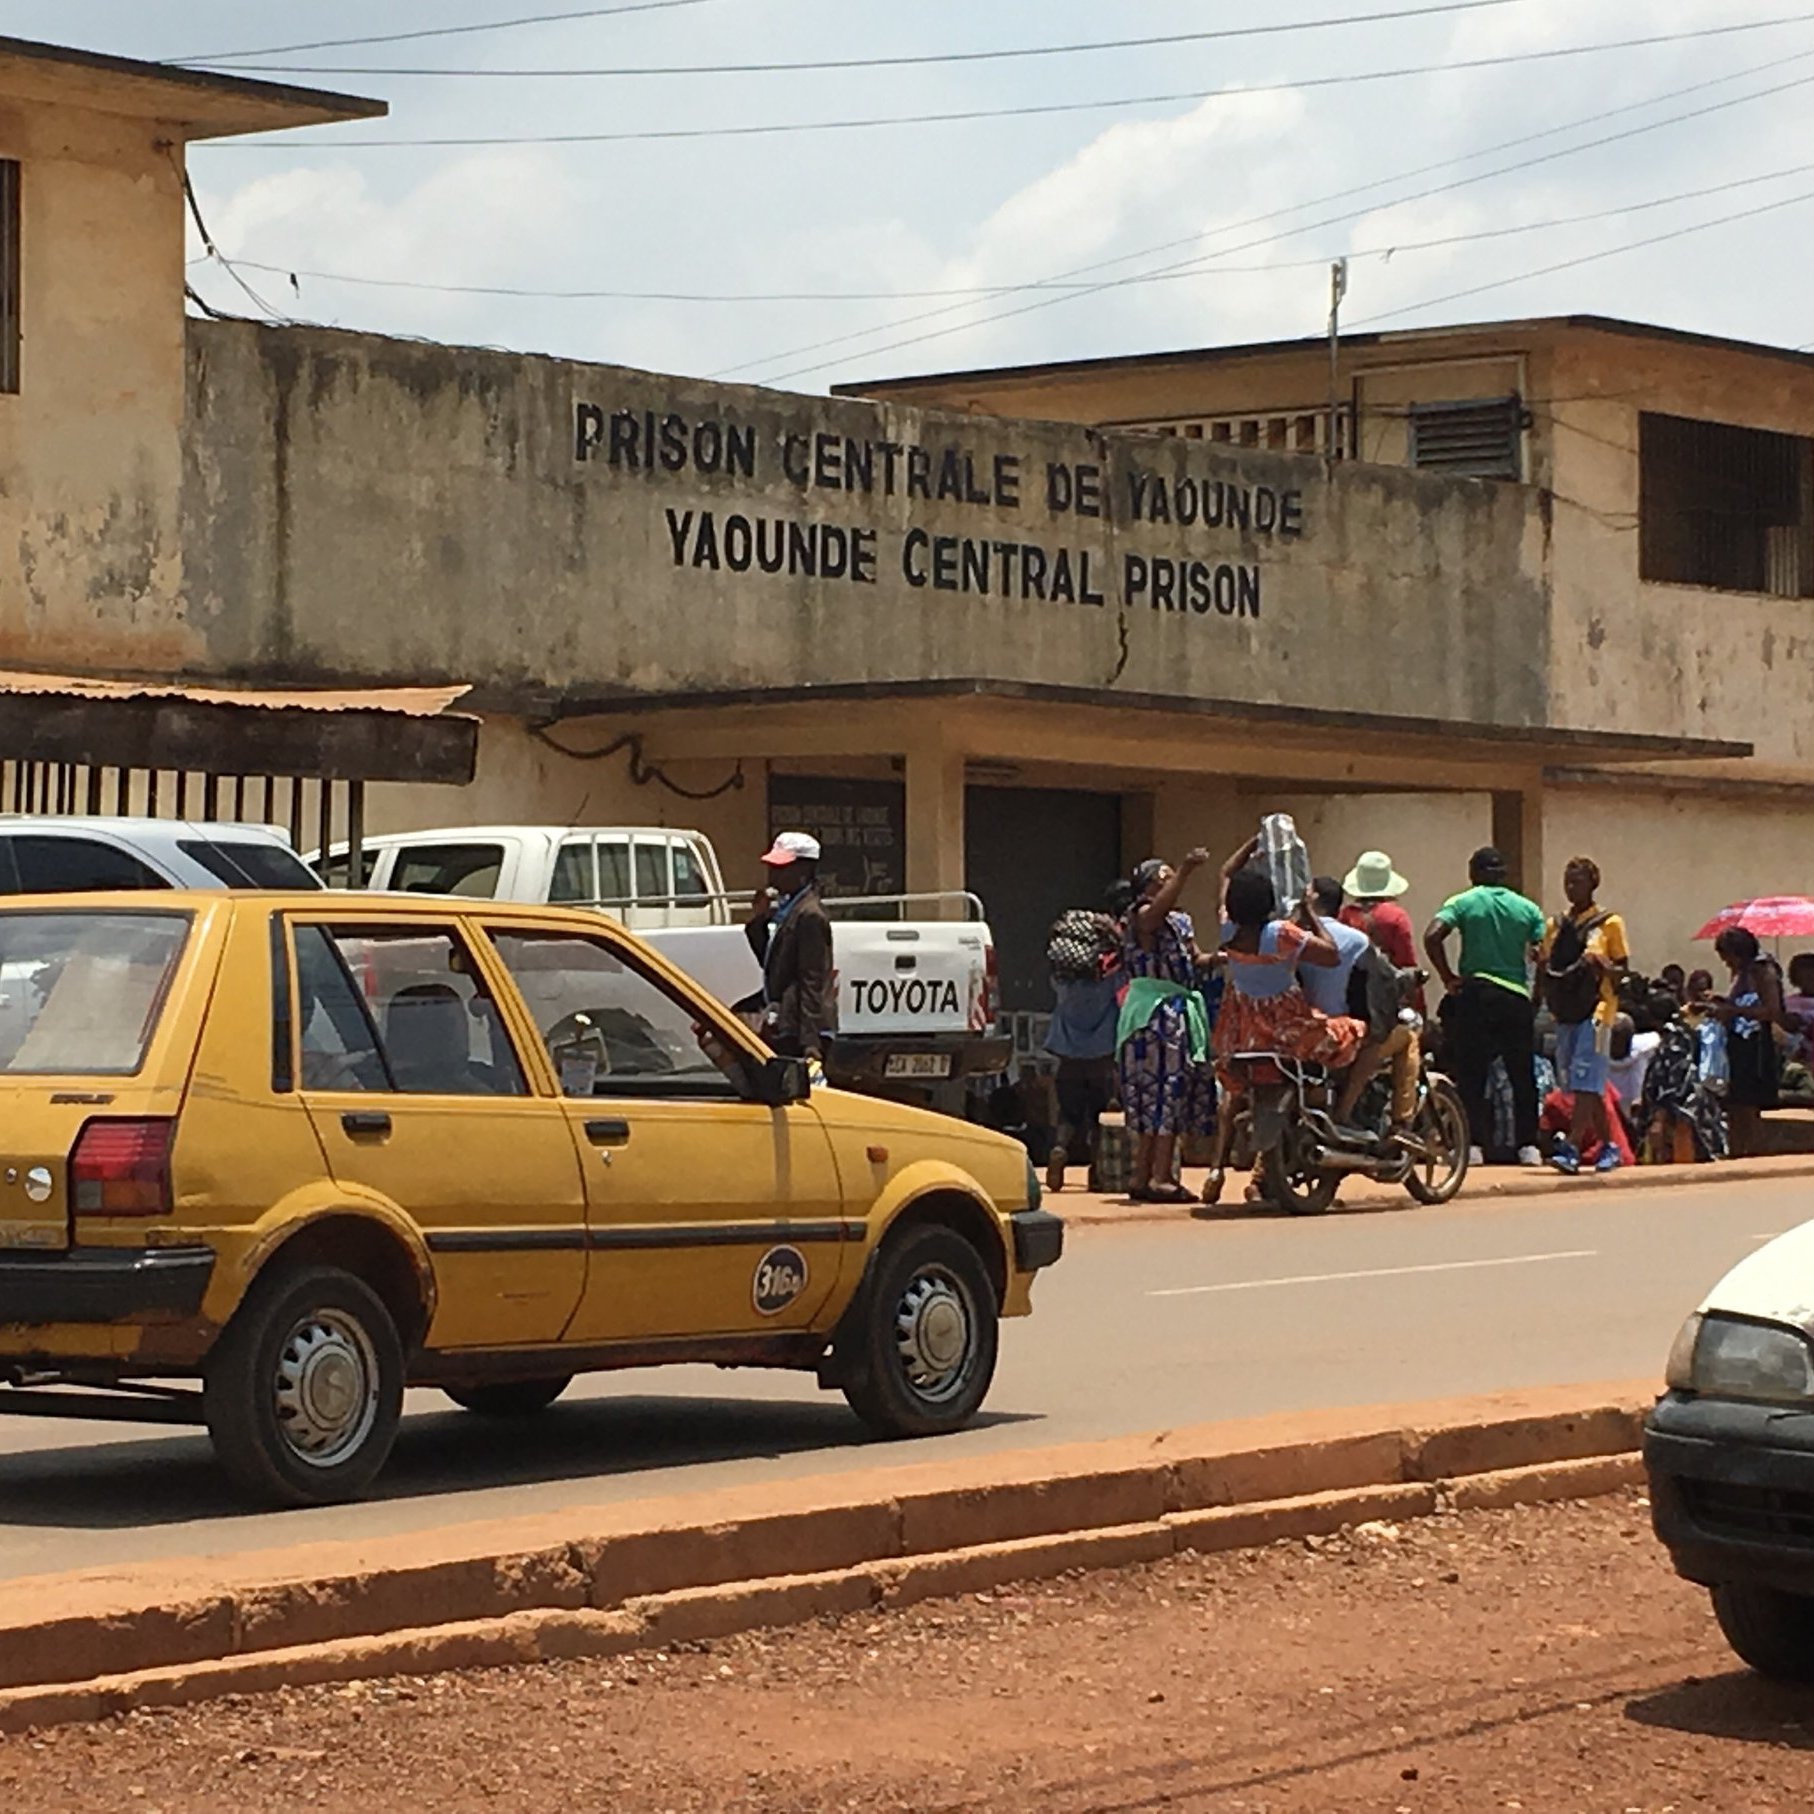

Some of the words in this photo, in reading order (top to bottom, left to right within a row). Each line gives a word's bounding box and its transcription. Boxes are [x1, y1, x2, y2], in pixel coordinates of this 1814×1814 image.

[575, 403, 756, 478] PRISON
[783, 432, 1020, 509] CENTRALE
[1044, 461, 1100, 518] DE
[1126, 471, 1303, 540] YAOUNDE
[665, 508, 877, 585] YAOUNDE
[903, 527, 1104, 607] CENTRAL
[1125, 554, 1260, 618] PRISON
[850, 980, 959, 1014] TOYOTA
